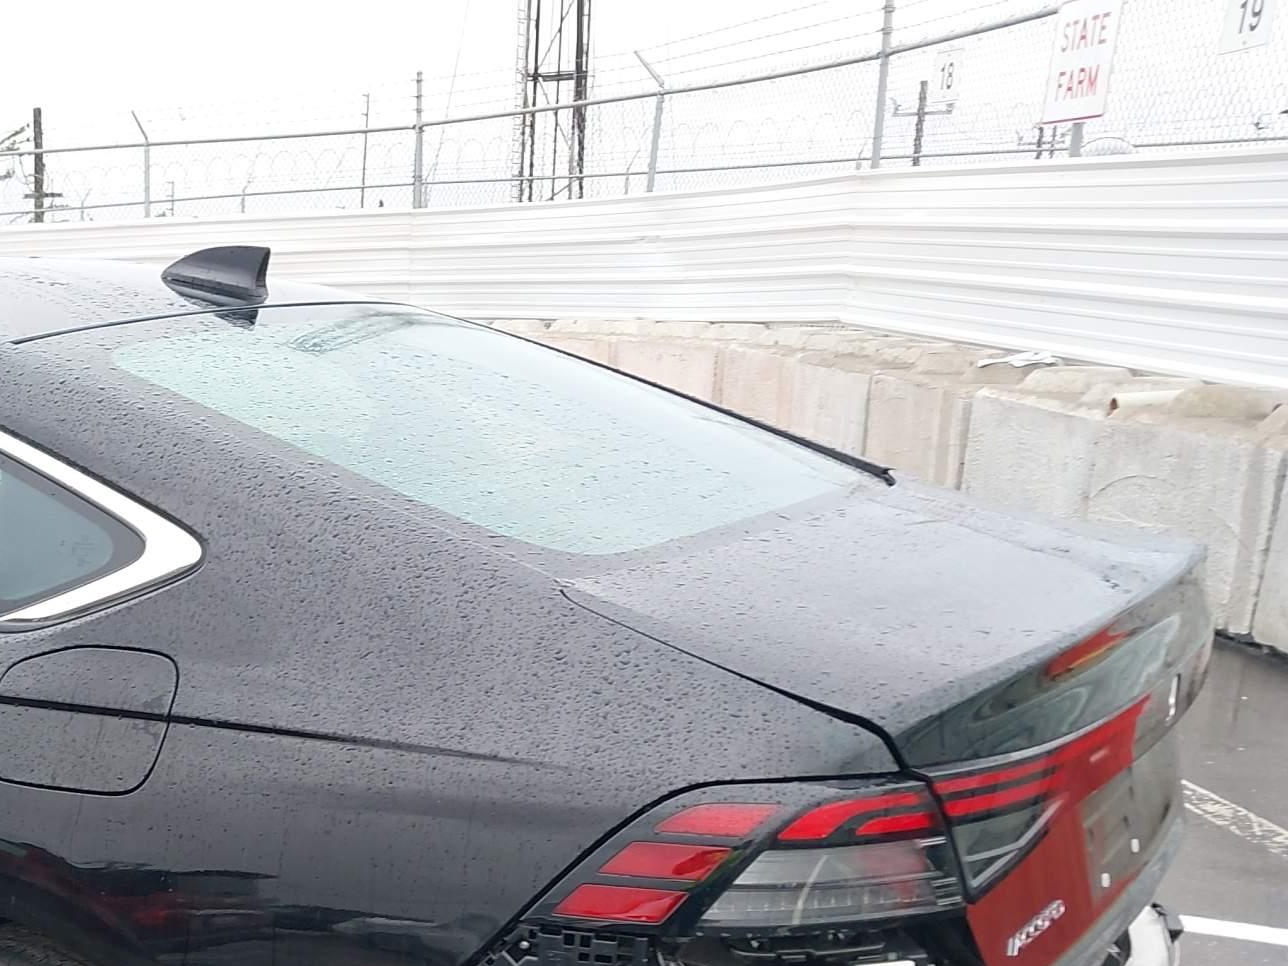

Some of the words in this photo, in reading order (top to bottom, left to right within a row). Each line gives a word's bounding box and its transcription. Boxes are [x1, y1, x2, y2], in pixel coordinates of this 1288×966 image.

[1061, 12, 1112, 52] STATE
[1238, 0, 1265, 34] 19
[940, 62, 955, 90] 18
[1055, 64, 1100, 102] FARM
